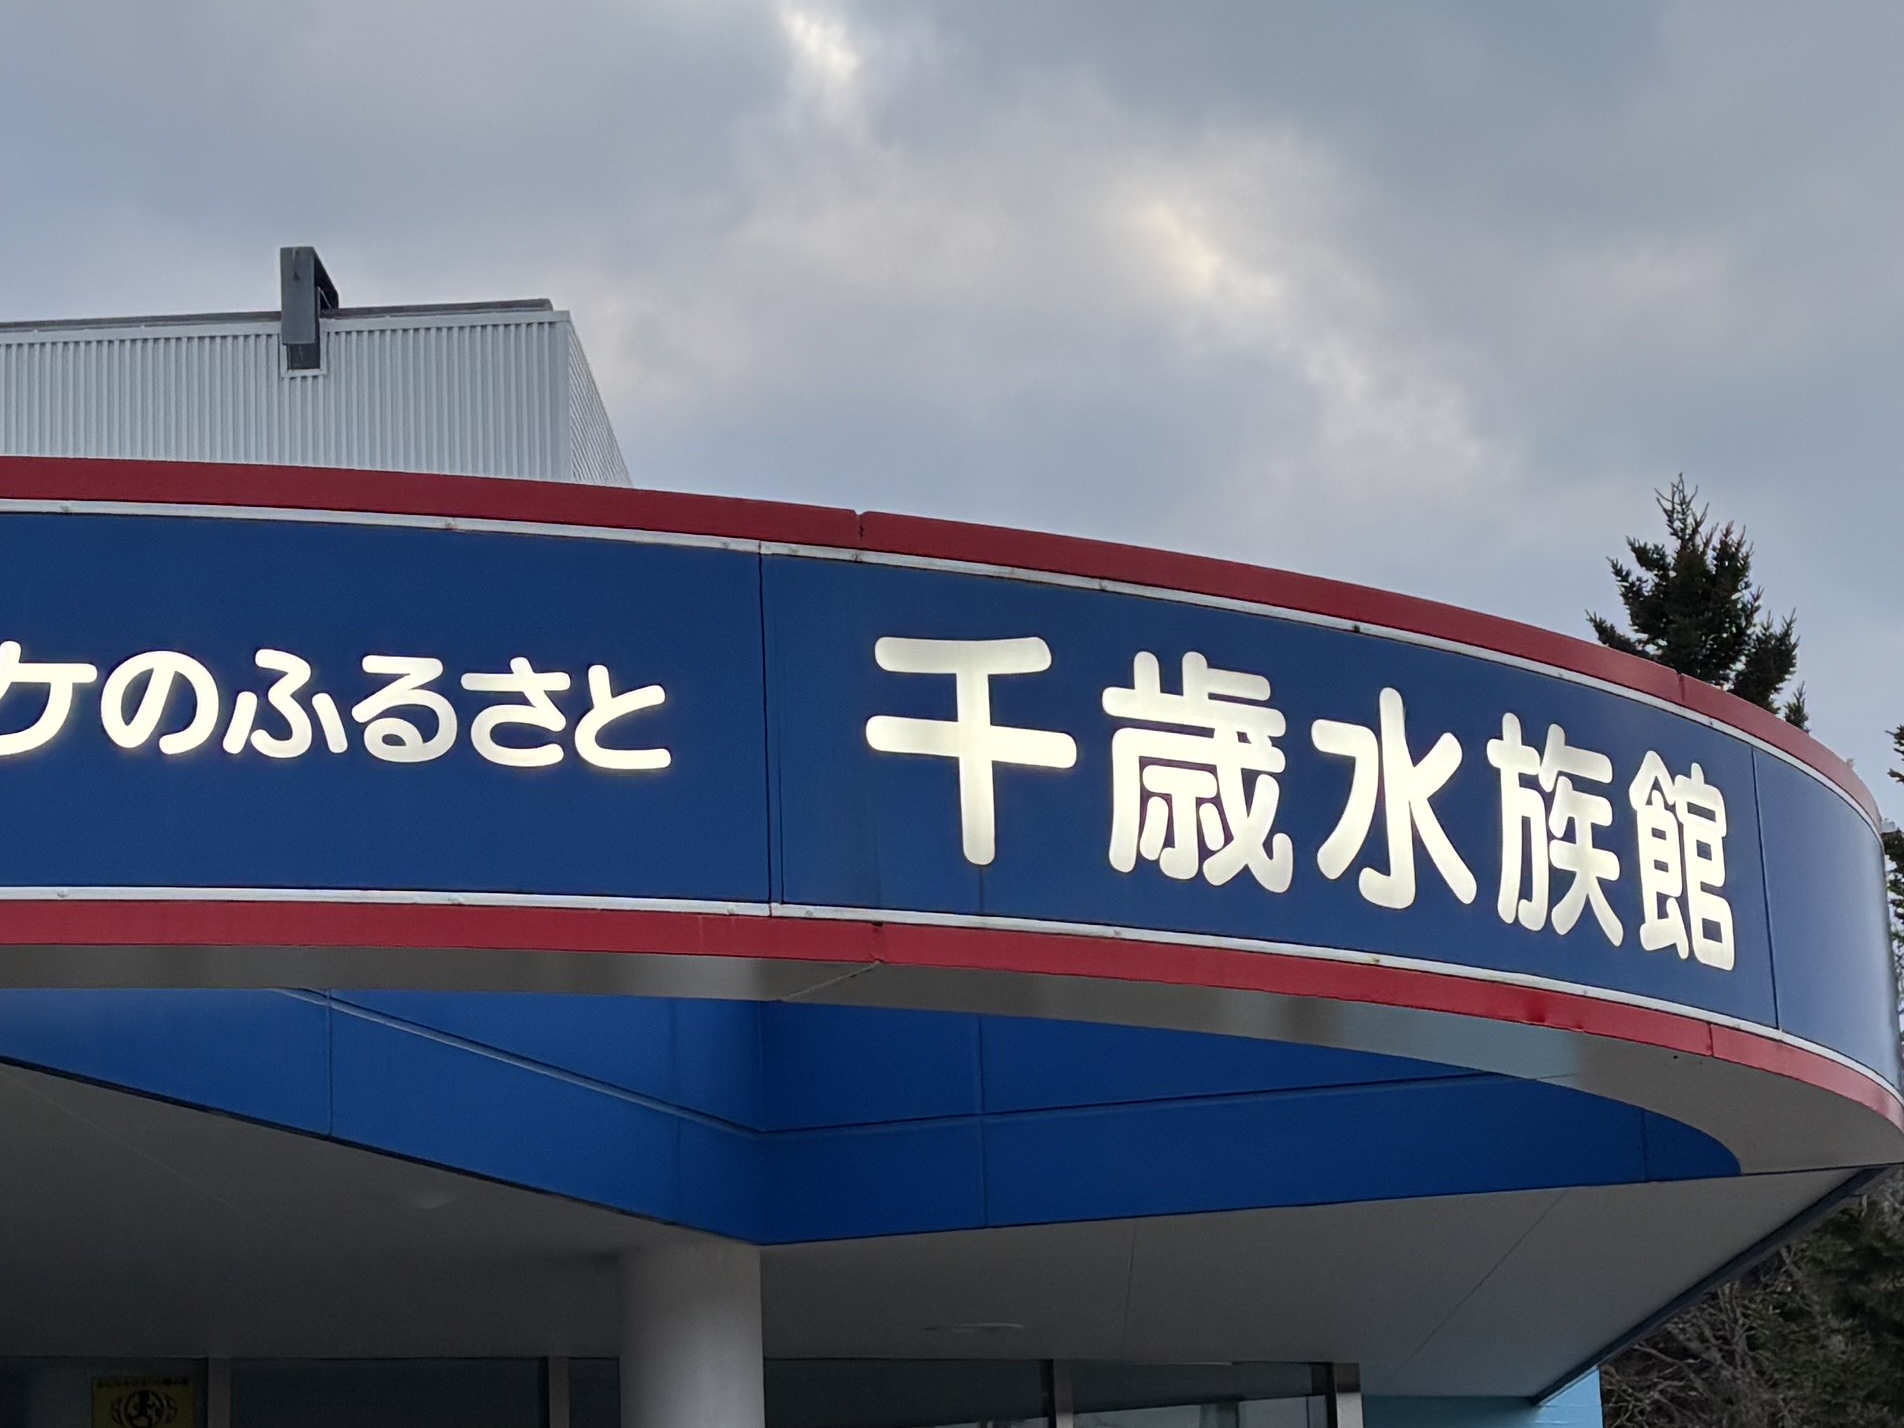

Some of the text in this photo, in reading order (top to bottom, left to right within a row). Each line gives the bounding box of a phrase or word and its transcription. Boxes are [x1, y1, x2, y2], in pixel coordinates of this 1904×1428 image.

[865, 635, 1736, 972] 千歳水族館
